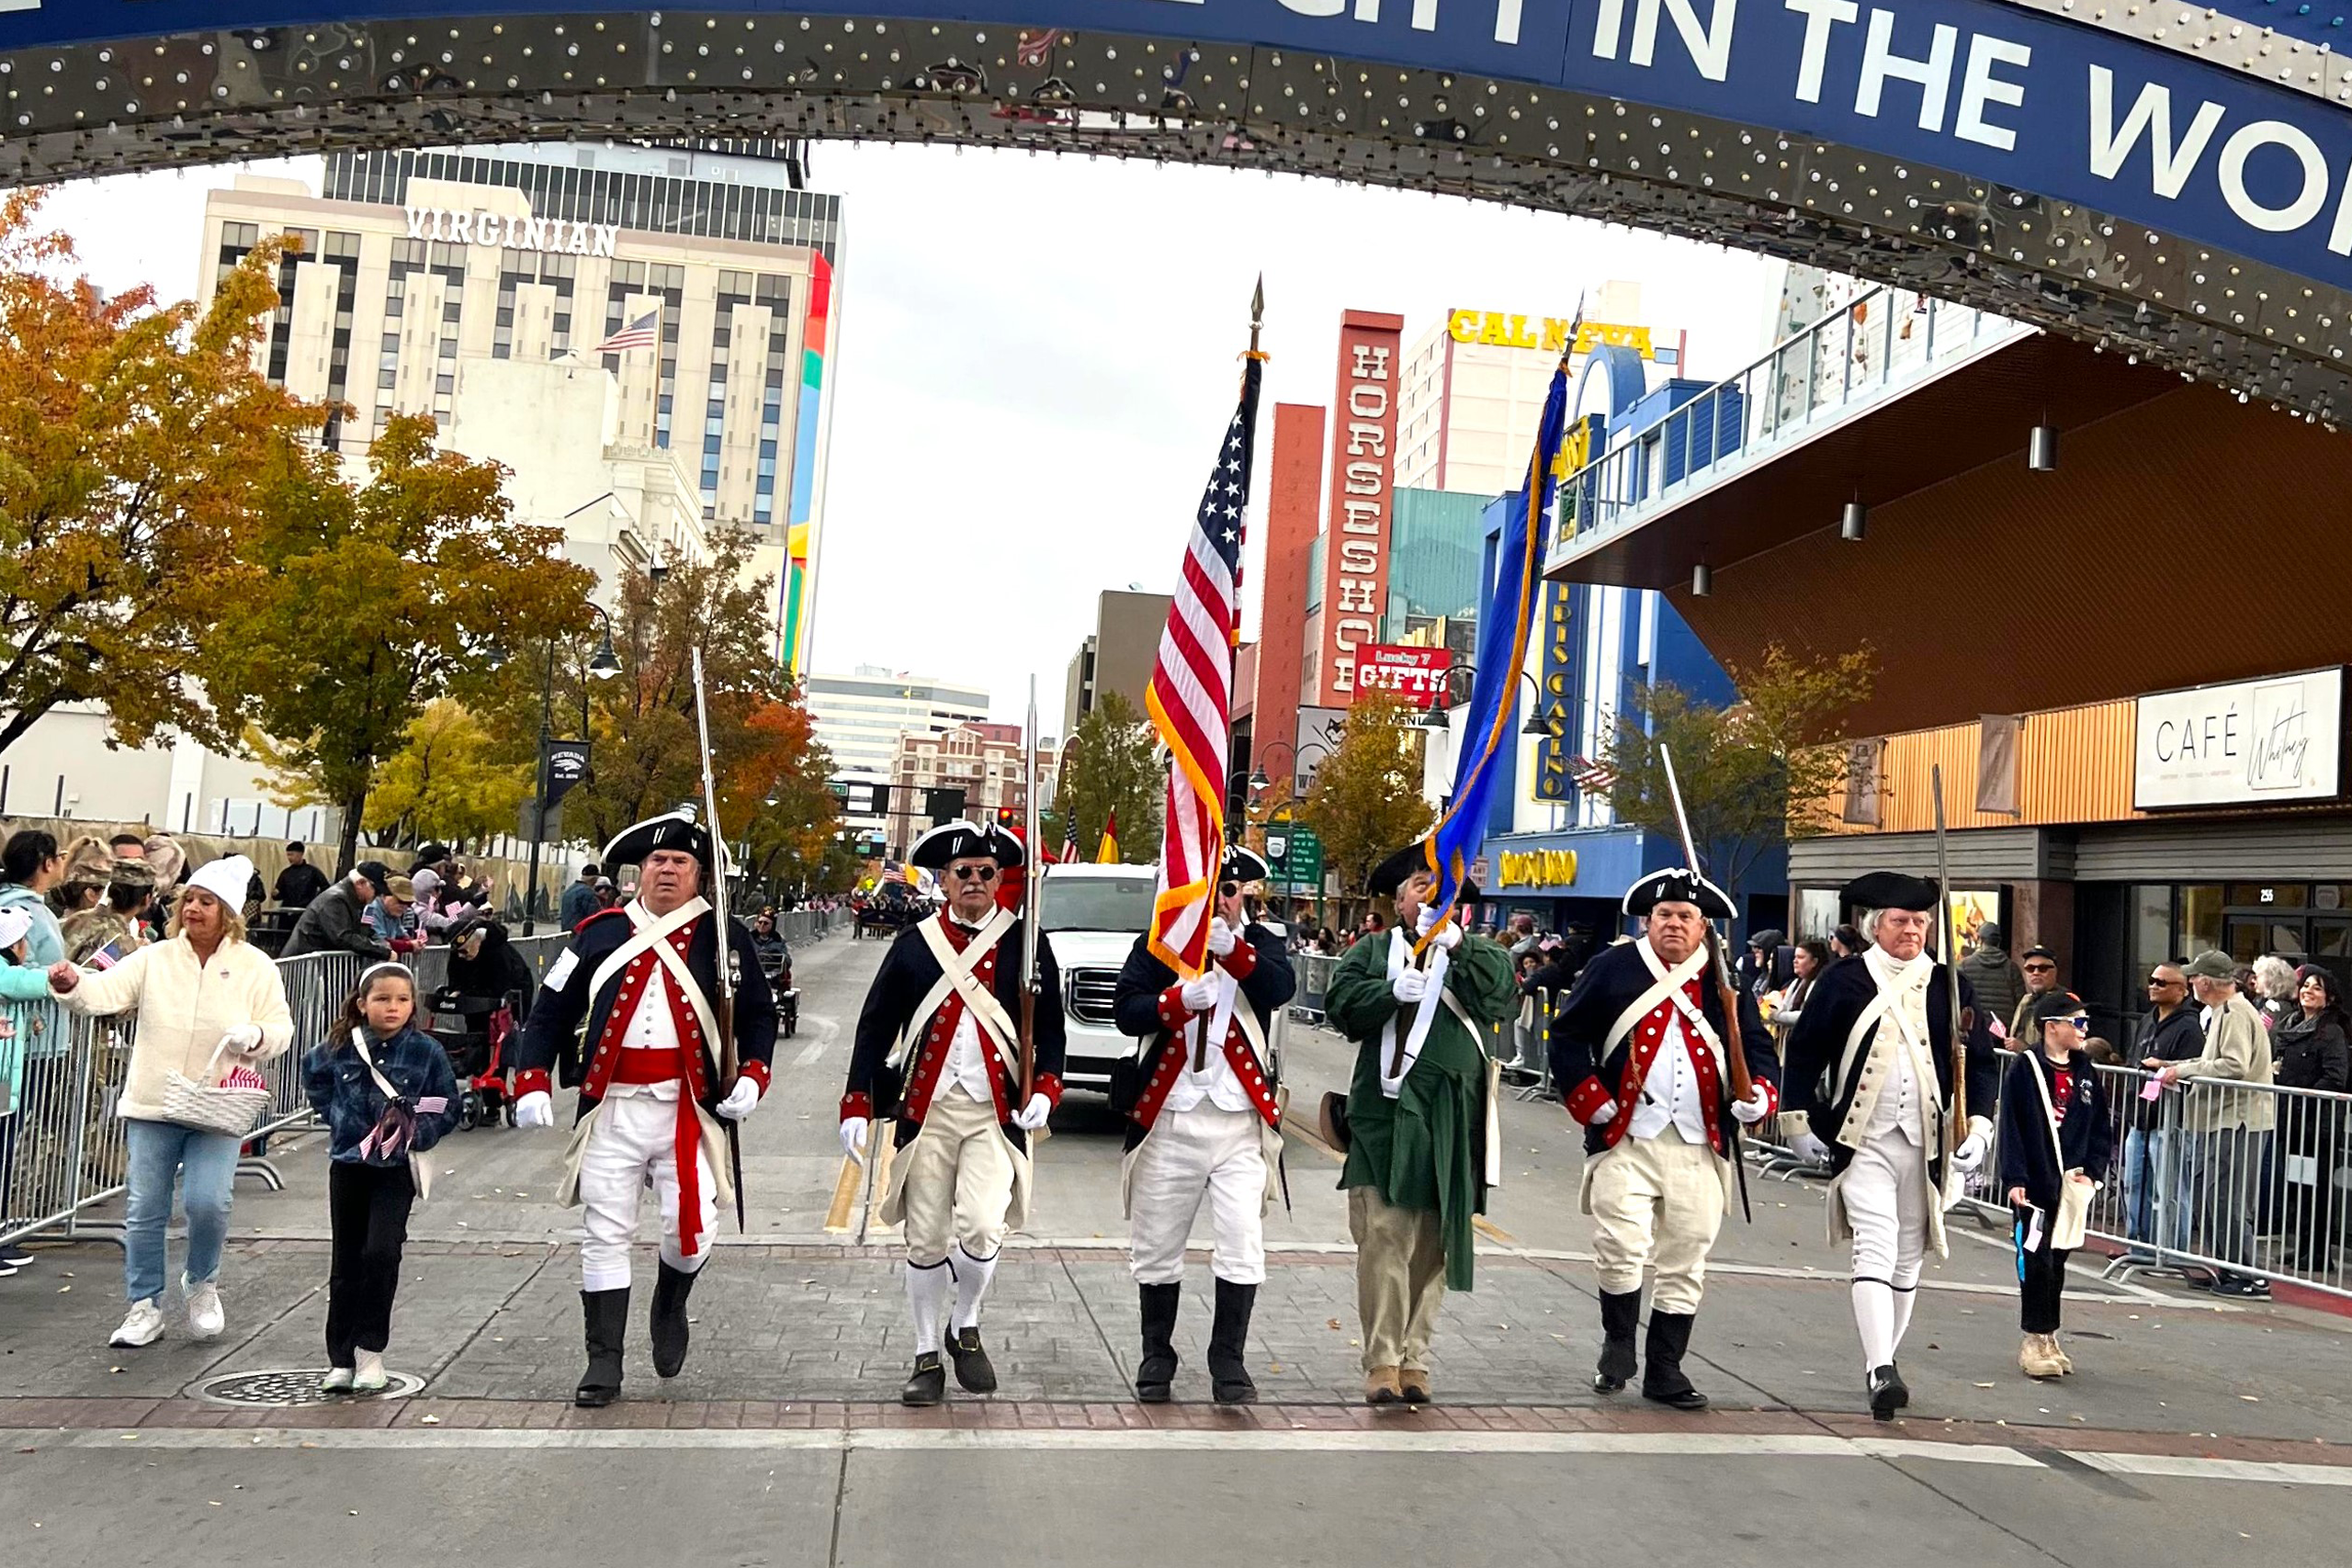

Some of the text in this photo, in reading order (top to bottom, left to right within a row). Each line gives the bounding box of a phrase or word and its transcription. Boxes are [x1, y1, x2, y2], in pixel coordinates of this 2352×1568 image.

[1592, 0, 2352, 257] IN THE WO
[404, 206, 620, 258] VIRGINIAN
[1448, 310, 1536, 349] CAL
[1375, 650, 1430, 666] Lucky 7
[1359, 664, 1447, 693] GIFTS
[2156, 702, 2238, 762] CAFÉ
[550, 751, 585, 762] NEVADA
